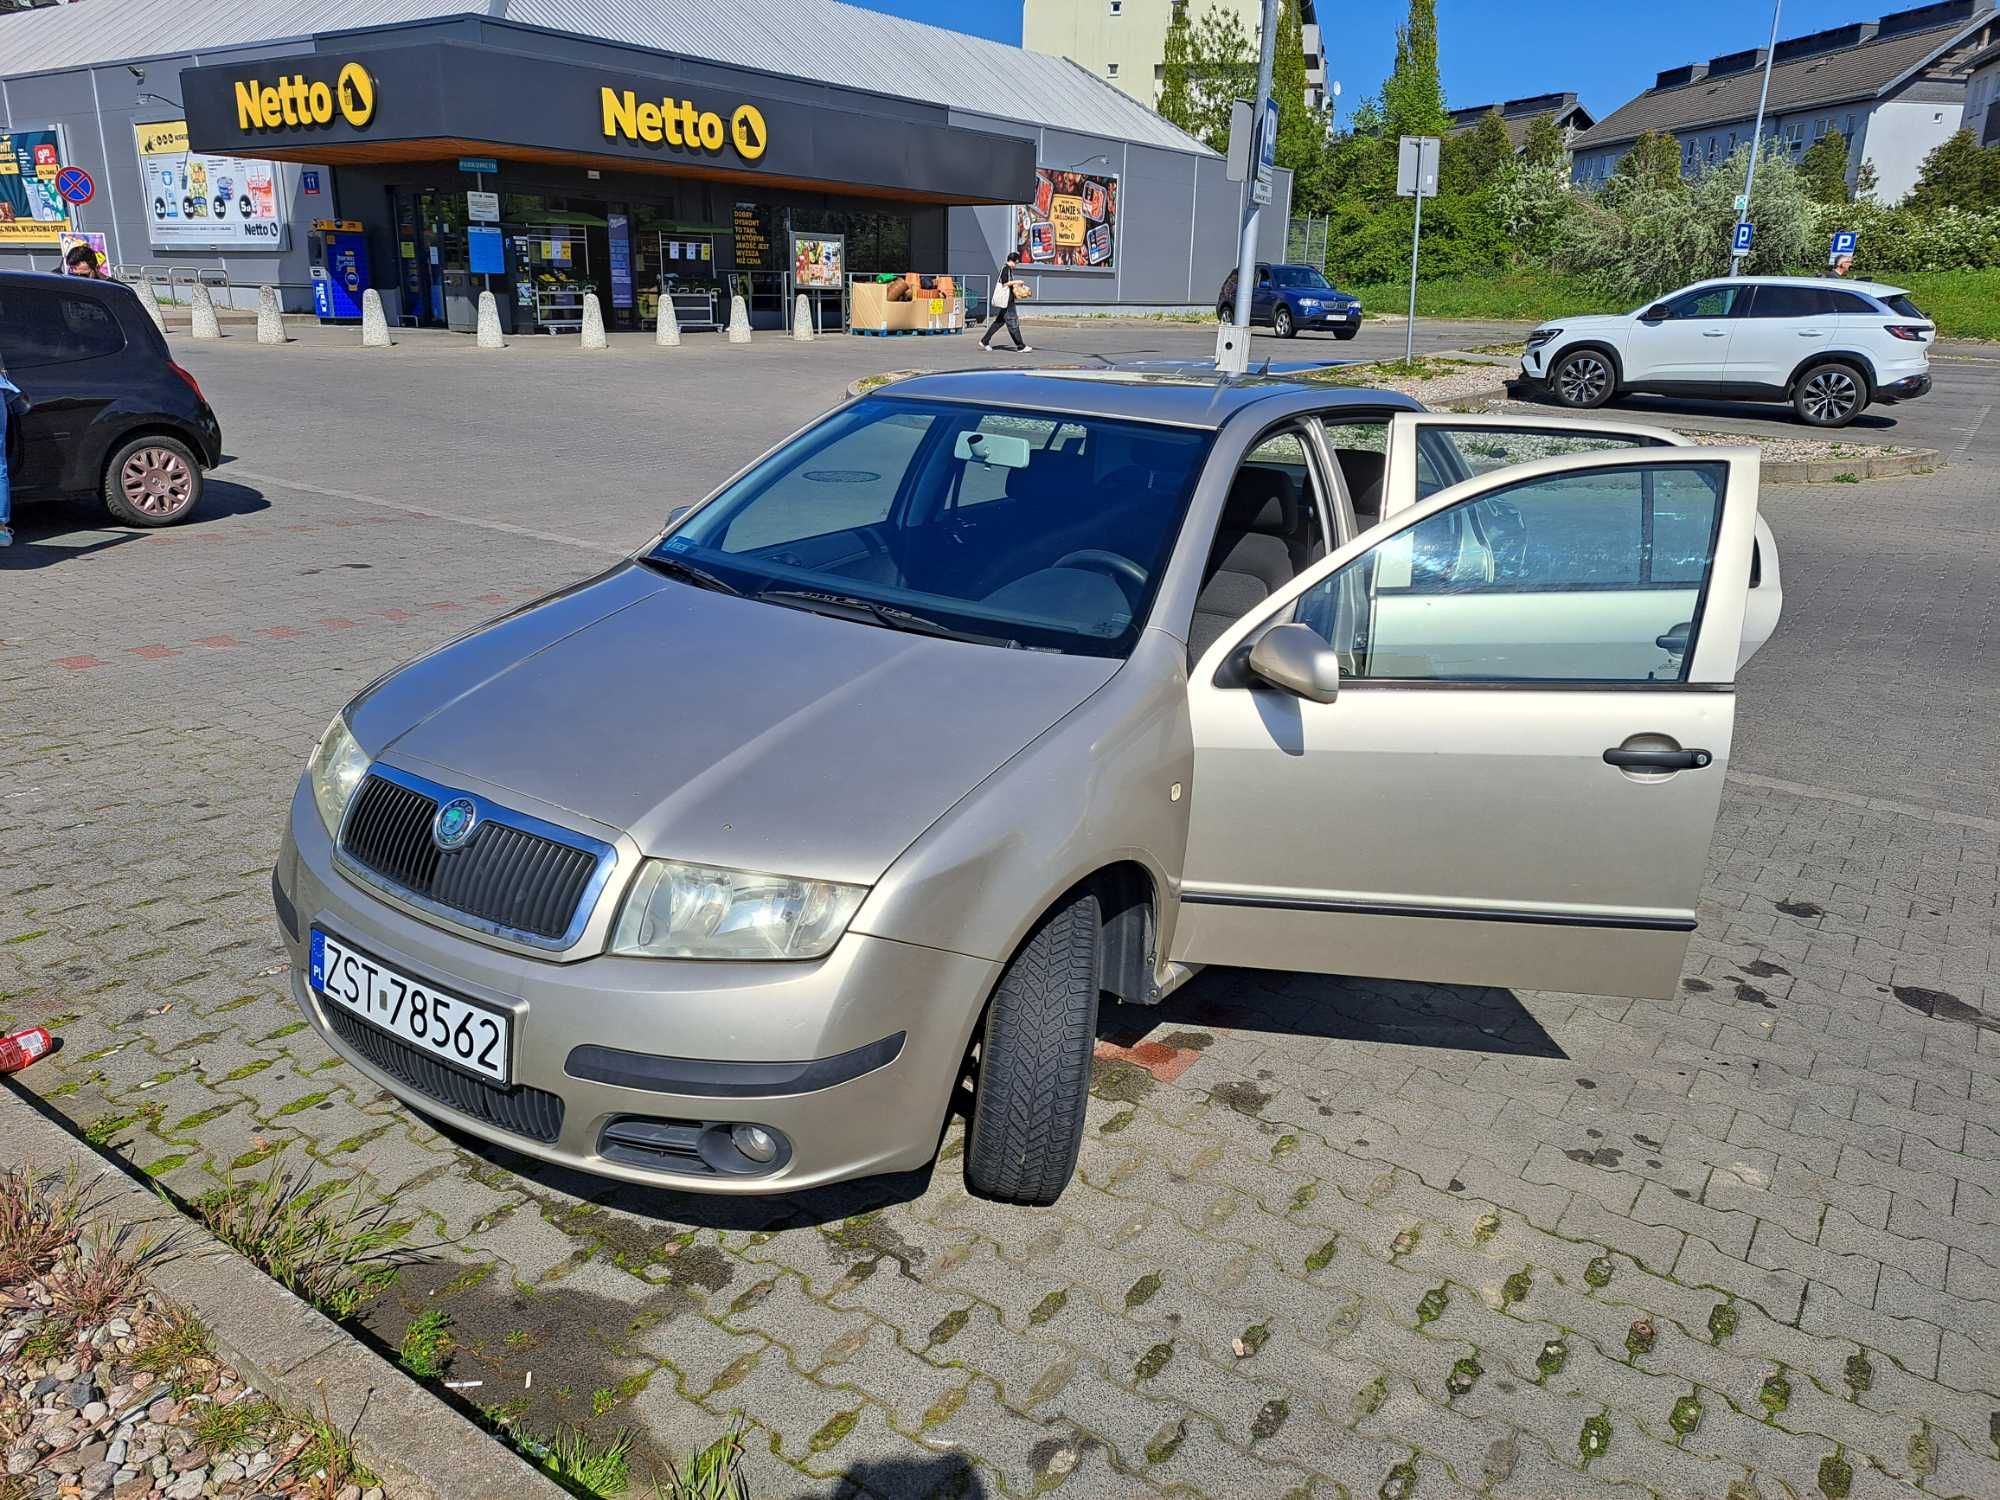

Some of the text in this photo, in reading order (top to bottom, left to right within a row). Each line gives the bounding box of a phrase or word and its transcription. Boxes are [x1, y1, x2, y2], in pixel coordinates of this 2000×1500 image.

[235, 74, 333, 130] Netto
[601, 87, 724, 151] Netto
[244, 223, 269, 236] Netto
[1738, 226, 1749, 247] P
[1837, 235, 1852, 251] P
[313, 964, 324, 982] PL
[325, 943, 501, 1073] ZST 78562
